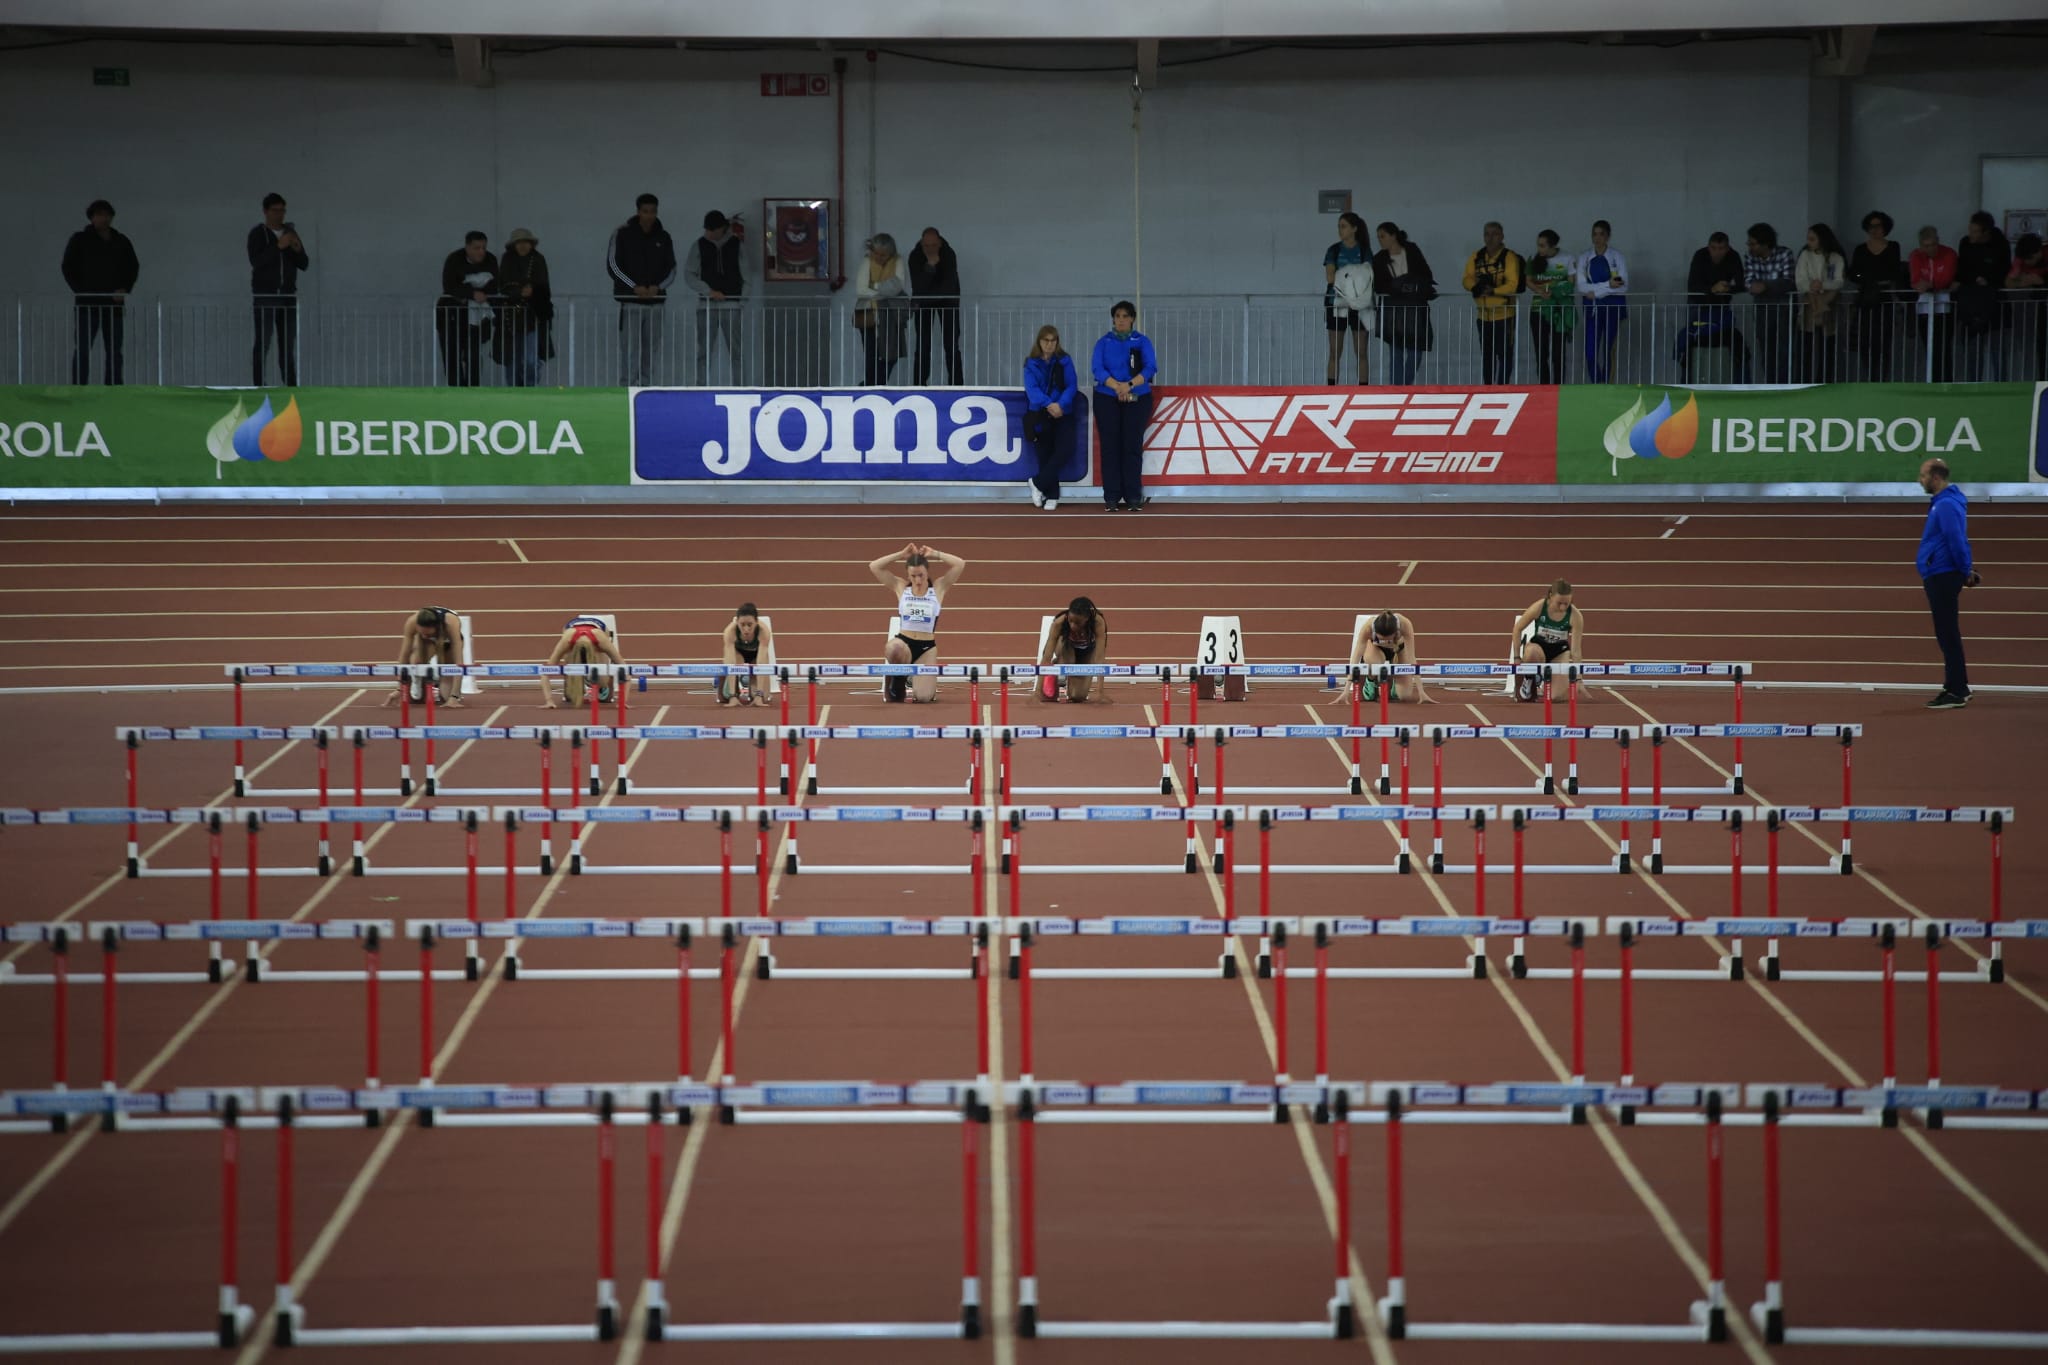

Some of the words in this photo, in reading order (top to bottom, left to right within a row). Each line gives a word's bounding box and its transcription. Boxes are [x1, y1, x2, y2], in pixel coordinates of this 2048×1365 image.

[315, 420, 584, 457] IBERDROLA
[1712, 417, 1983, 453] IBERDROLA
[1260, 451, 1504, 474] ATLETISMO
[1205, 632, 1216, 664] 3
[1229, 629, 1237, 663] 3
